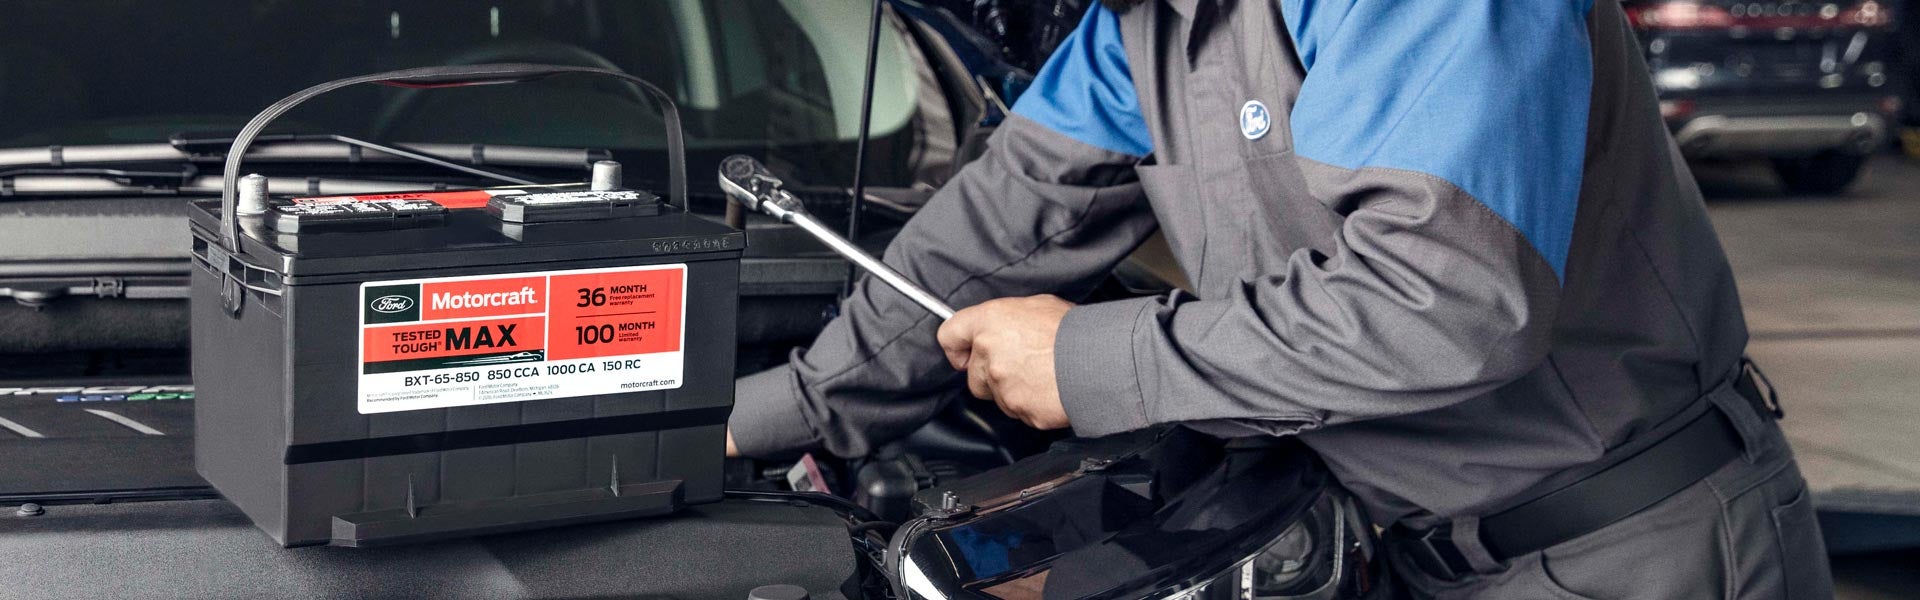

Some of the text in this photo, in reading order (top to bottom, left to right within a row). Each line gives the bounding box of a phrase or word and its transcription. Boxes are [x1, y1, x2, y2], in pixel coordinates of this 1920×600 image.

[377, 296, 406, 311] Ford
[431, 286, 536, 311] Motorcraft
[576, 284, 647, 308] 36 MONTH
[392, 330, 441, 342] TESTED
[445, 324, 517, 351] MAX
[575, 321, 655, 346] 100 MONTH
[404, 359, 641, 387] BXT-65-850 850 CCA 1000 CA 150 RC
[620, 379, 676, 389] motorcraft.com
